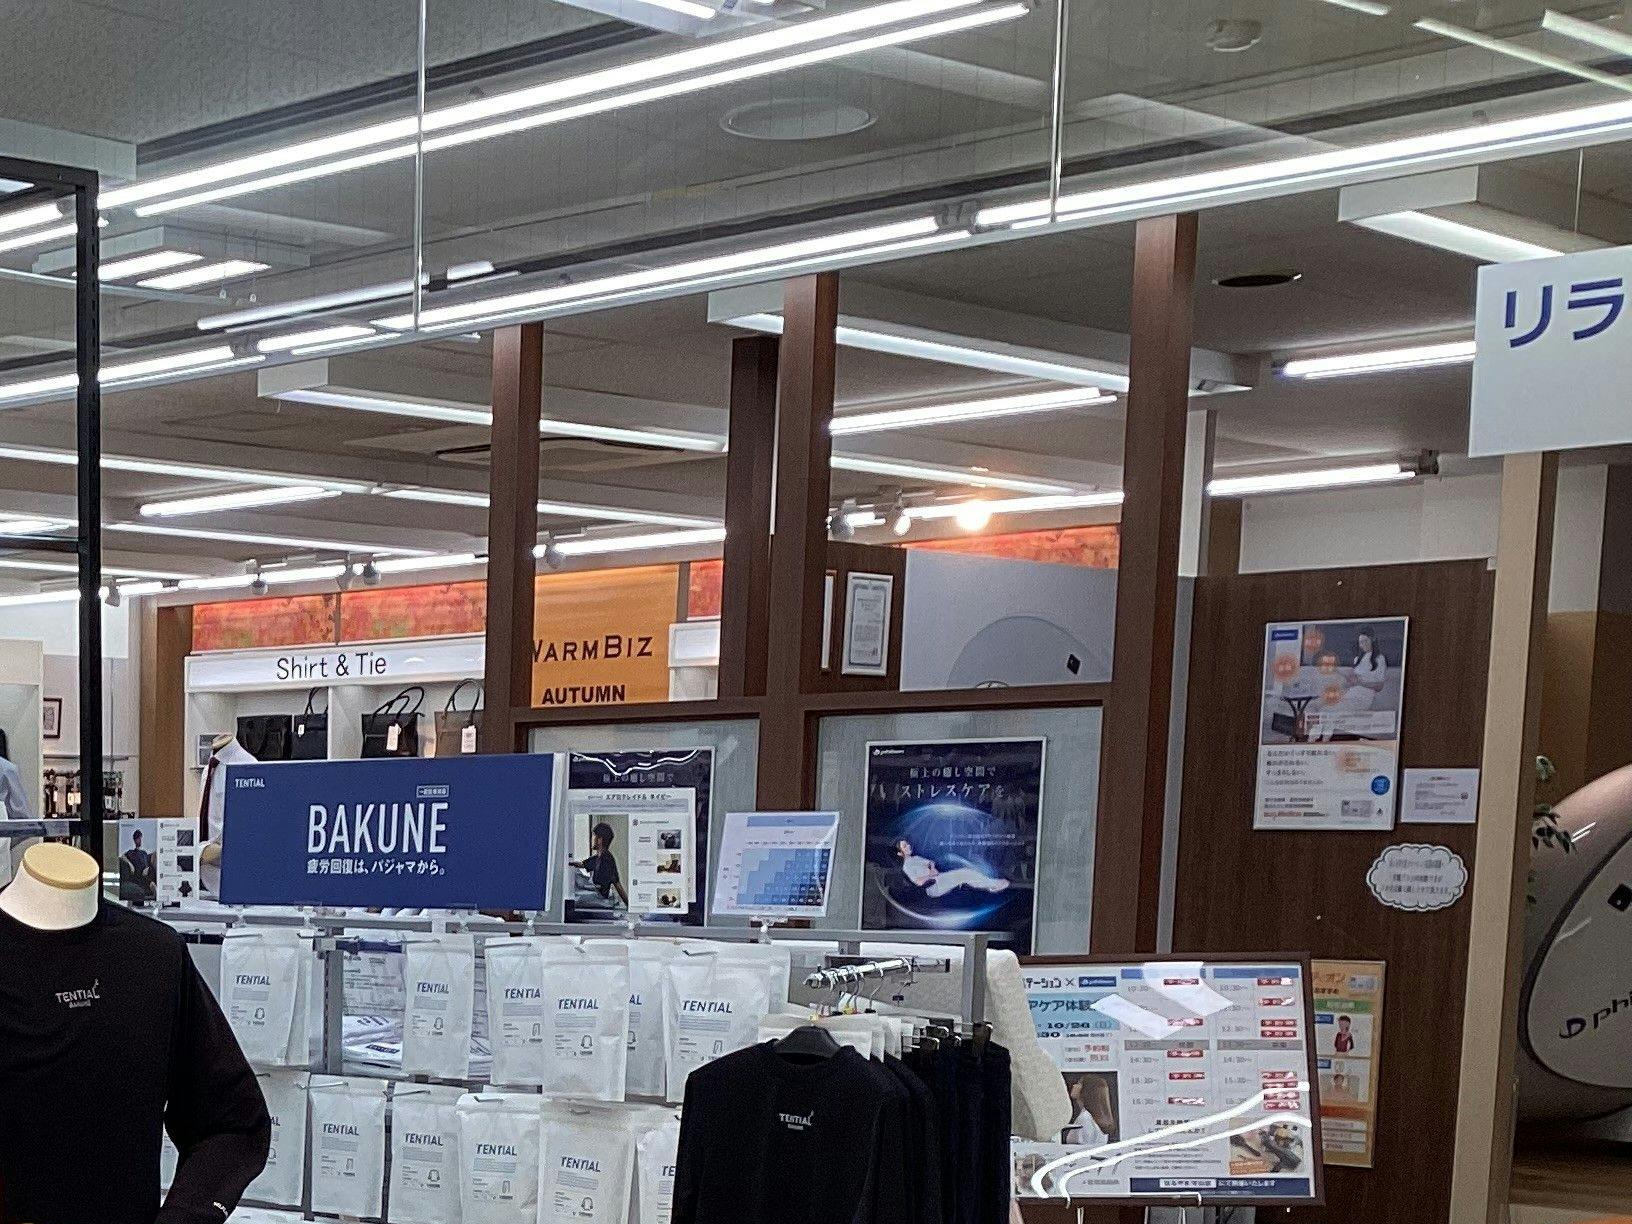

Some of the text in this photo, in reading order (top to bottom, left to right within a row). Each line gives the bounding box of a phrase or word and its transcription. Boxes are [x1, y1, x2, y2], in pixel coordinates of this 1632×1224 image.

[1504, 277, 1625, 349] リラ
[276, 652, 387, 680] Shirt & Tie
[542, 684, 625, 705] AUTUMN
[234, 778, 266, 788] TENTIAL
[306, 801, 450, 855] BAKUNE
[306, 858, 445, 875] 疲労回復は、パジャマから。
[235, 974, 271, 986] TENTIAL
[55, 987, 101, 1003] TENTIAL
[417, 982, 450, 994] TENTIAL
[504, 987, 541, 1000] TENTIA
[557, 998, 600, 1011] TENTIAL
[683, 999, 733, 1014] TENTIAL
[322, 1123, 360, 1136] TENTIAL
[404, 1132, 444, 1147] TENTIAL
[476, 1143, 518, 1157] TENTIAL
[560, 1156, 601, 1173] TENTIAL
